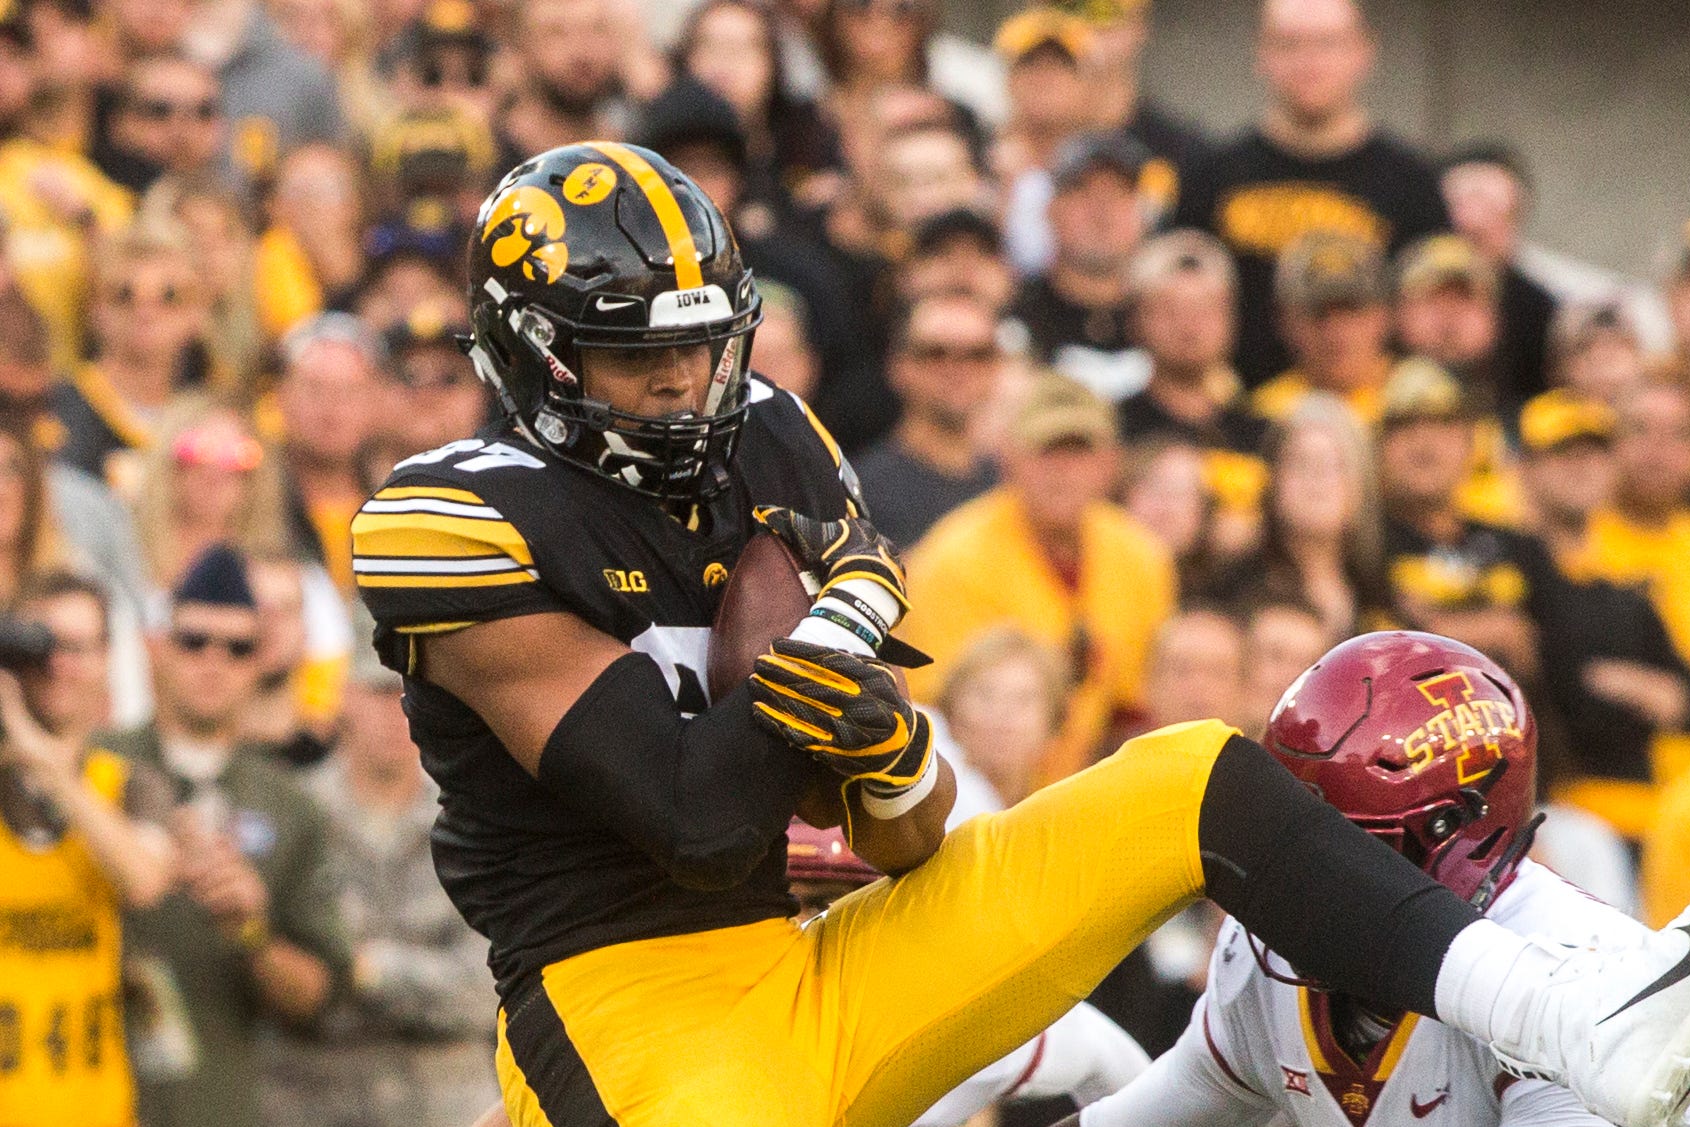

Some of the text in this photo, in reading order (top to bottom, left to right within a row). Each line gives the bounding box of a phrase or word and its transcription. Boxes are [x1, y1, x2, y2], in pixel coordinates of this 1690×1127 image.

[676, 290, 710, 308] IOWA
[854, 599, 889, 637] GODSTRO
[1403, 701, 1525, 774] STATE
